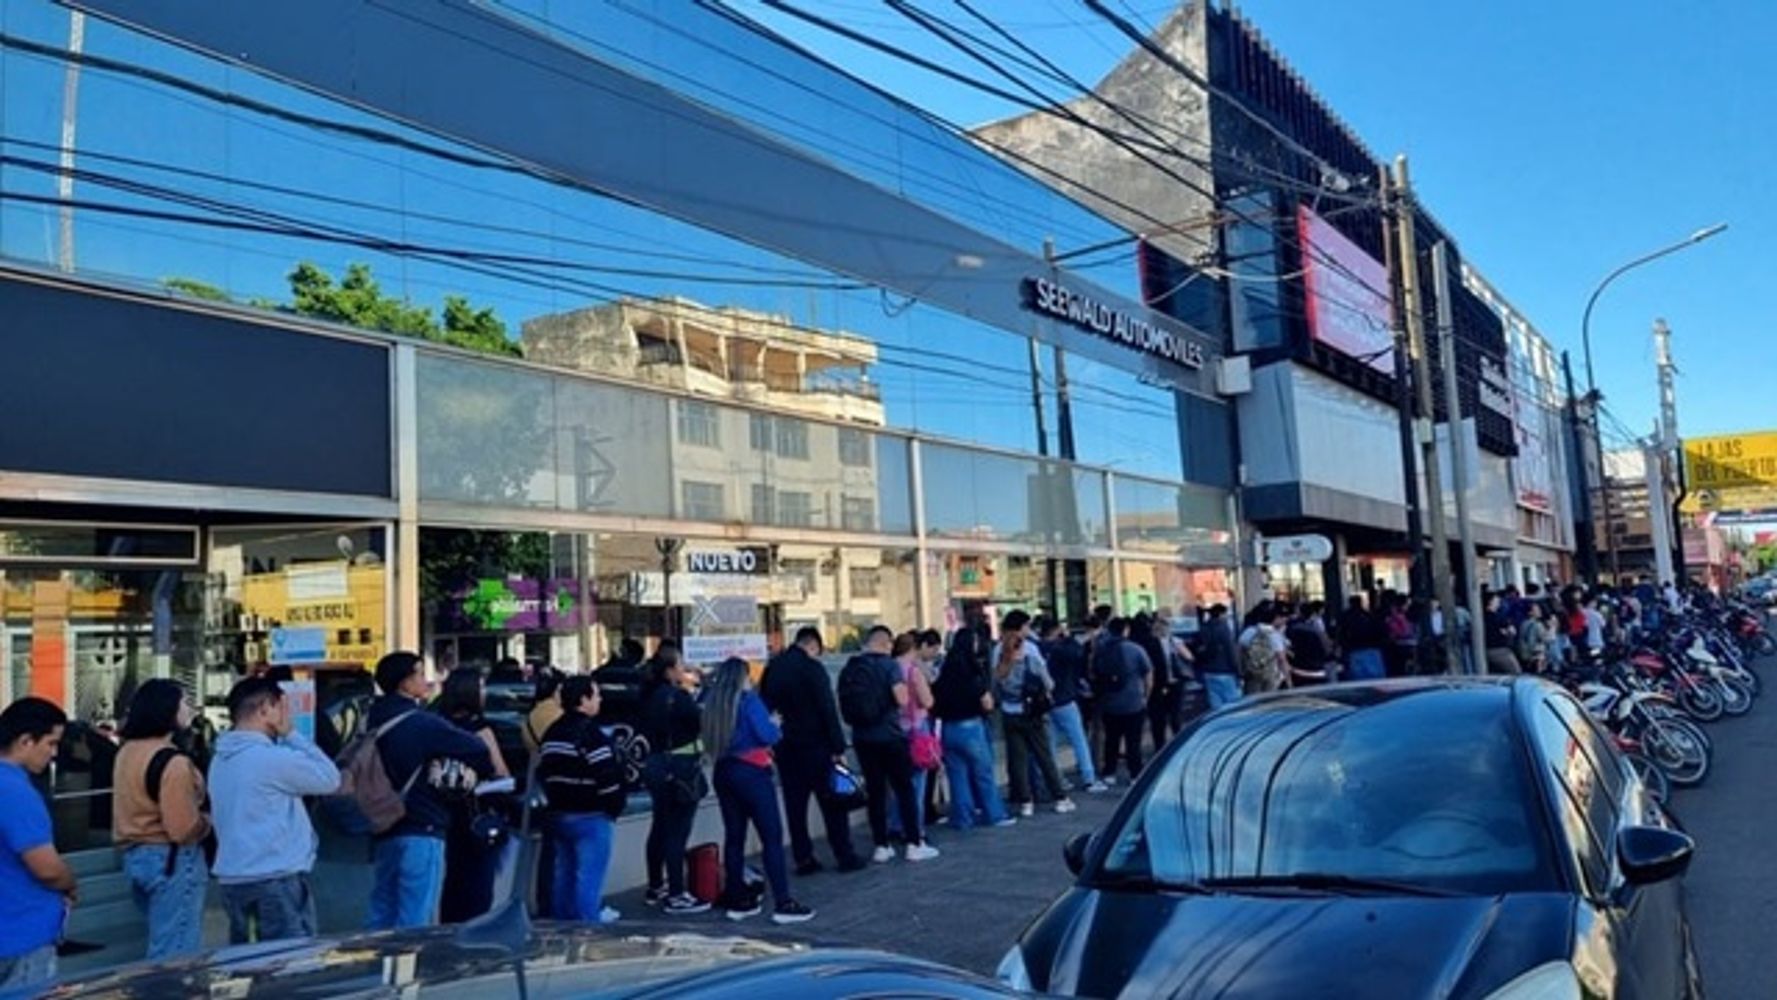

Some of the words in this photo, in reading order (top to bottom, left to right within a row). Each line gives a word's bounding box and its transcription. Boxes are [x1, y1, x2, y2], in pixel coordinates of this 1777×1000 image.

[1036, 277, 1112, 330] SEEWALD
[1113, 311, 1204, 369] AUTOMOVILES
[690, 550, 756, 572] NUEVO
